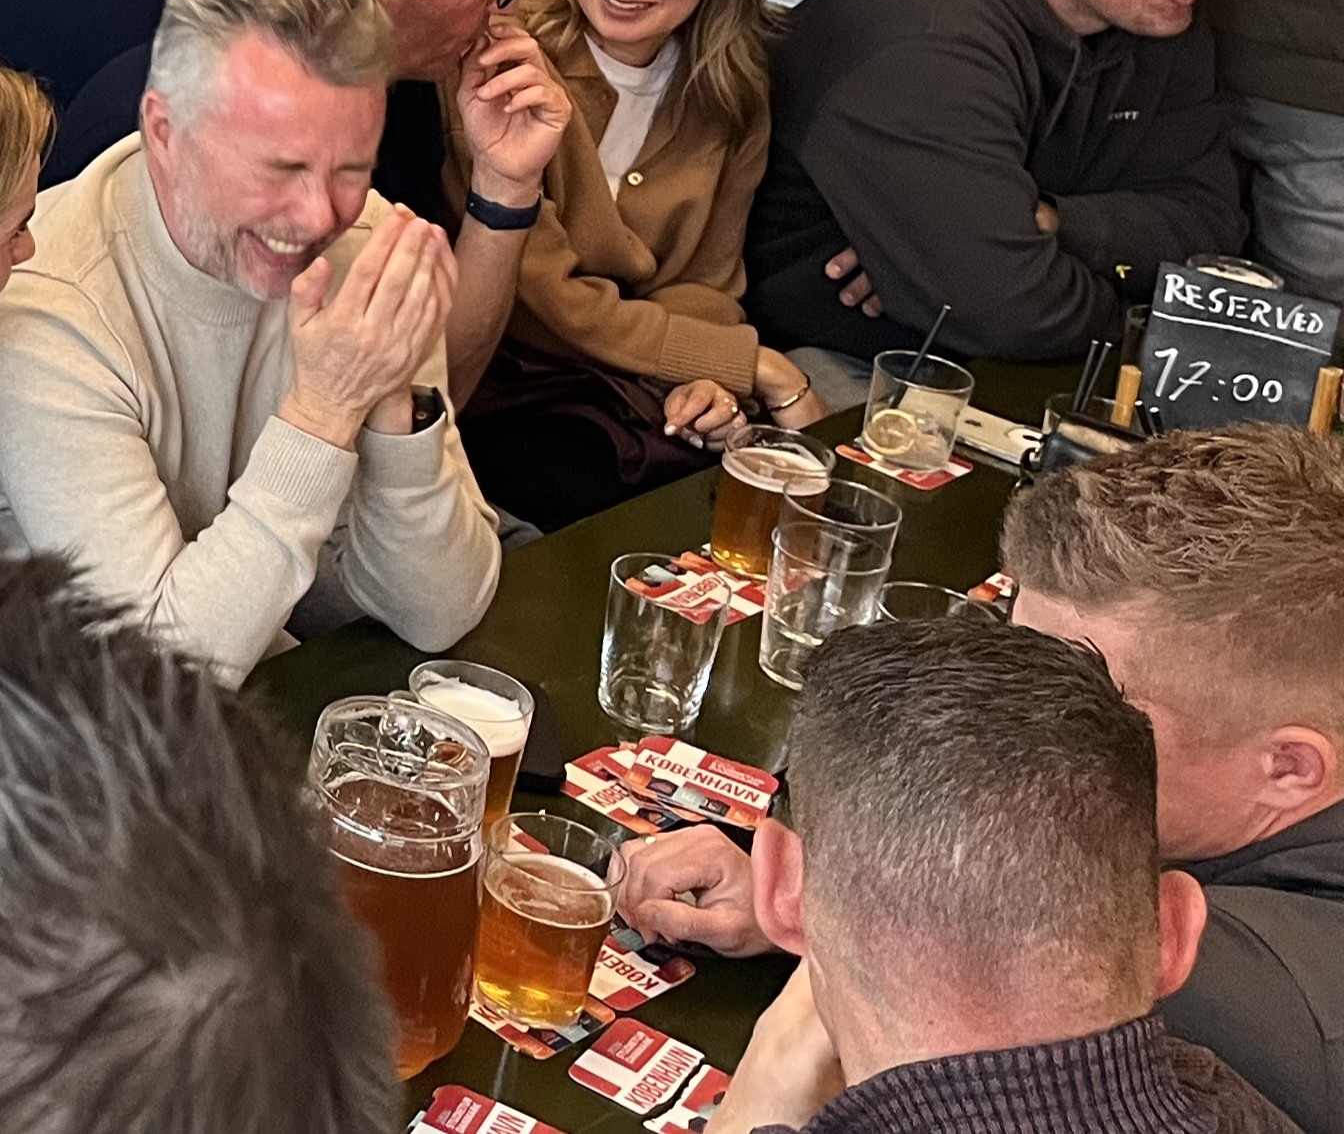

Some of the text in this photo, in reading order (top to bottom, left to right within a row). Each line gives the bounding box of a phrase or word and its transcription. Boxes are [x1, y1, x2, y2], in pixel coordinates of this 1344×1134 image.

[1164, 273, 1324, 334] RESERVED
[1154, 347, 1283, 403] 17:00
[644, 753, 760, 804] KØBENHAVN
[623, 1045, 698, 1110] KØBENHAVN
